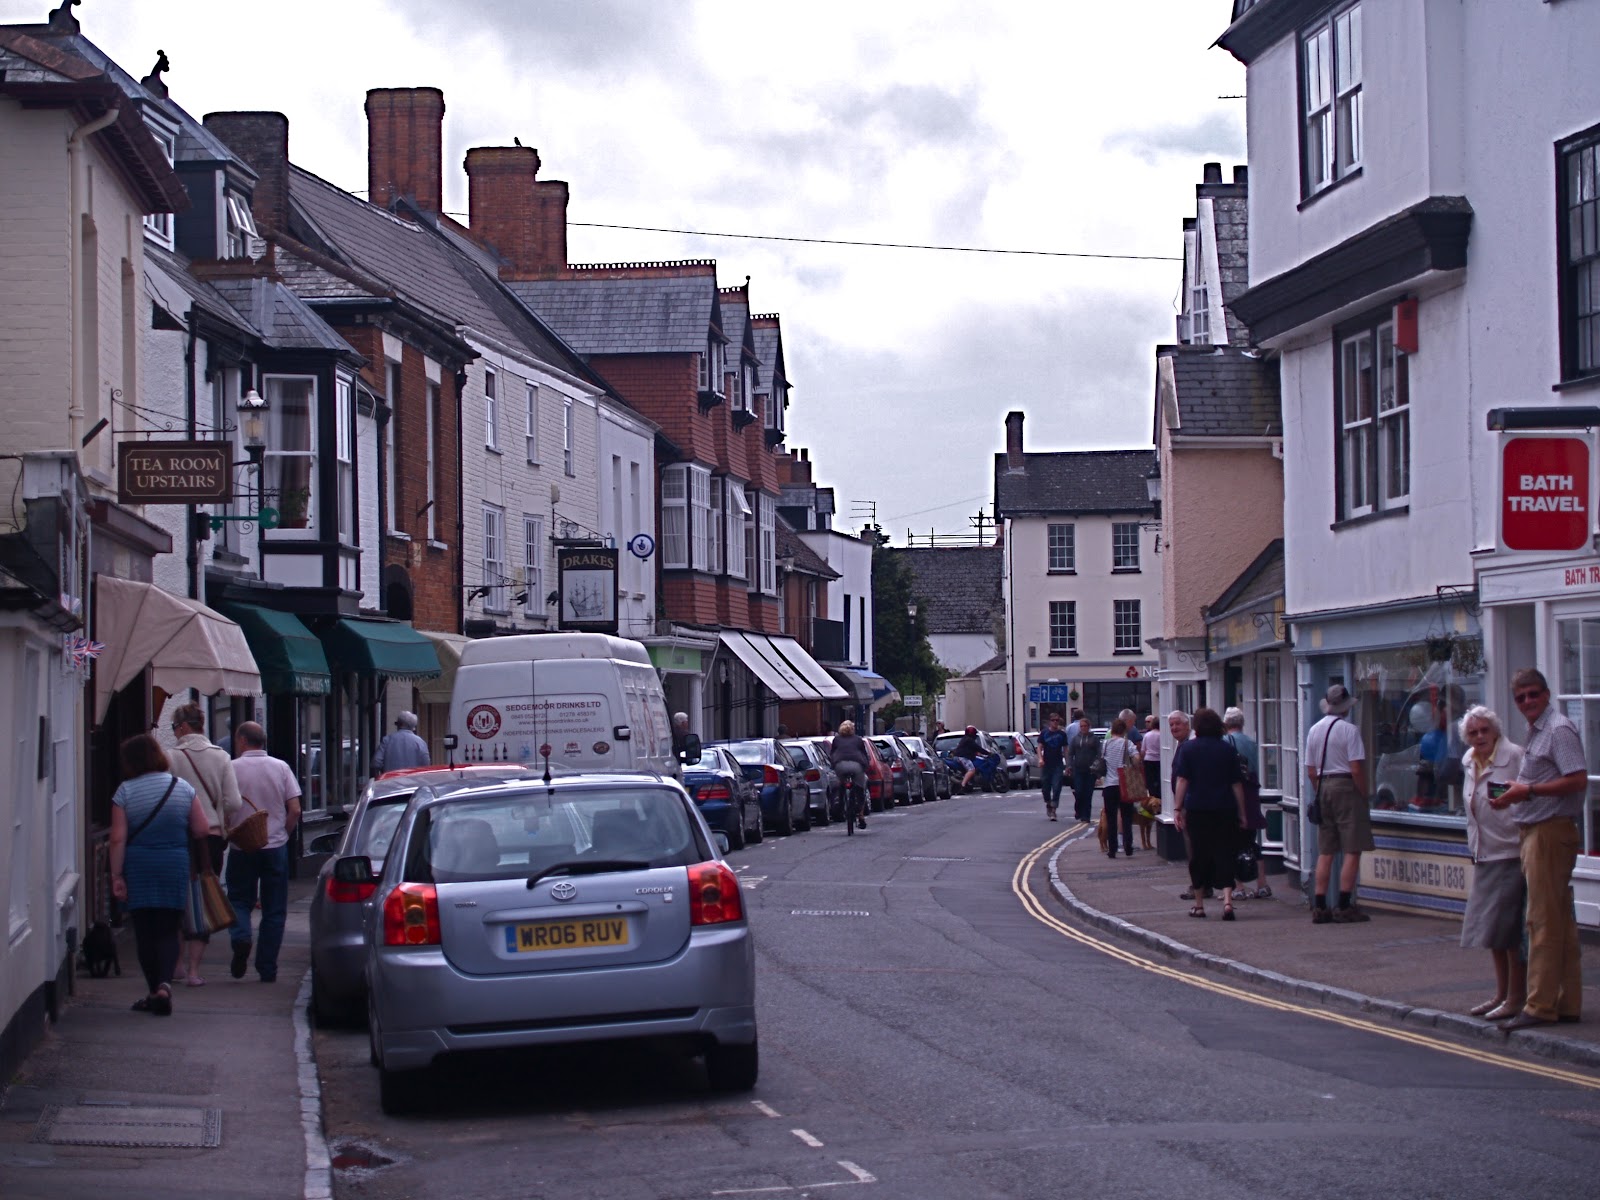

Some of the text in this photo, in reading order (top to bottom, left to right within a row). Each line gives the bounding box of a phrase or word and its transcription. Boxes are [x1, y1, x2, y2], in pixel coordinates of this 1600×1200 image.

[130, 458, 220, 471] TEA ROOM
[136, 475, 215, 488] UPSTAIRS
[1520, 475, 1573, 490] BATH
[1508, 496, 1585, 512] TRAVEL
[562, 554, 614, 570] DRAKES
[1565, 568, 1586, 586] BATH
[505, 703, 554, 711] SEDGEMOOR
[1374, 857, 1465, 890] ESTABLISHED 1838
[636, 886, 673, 895] COROLLA
[520, 921, 625, 948] WR06 RUV
